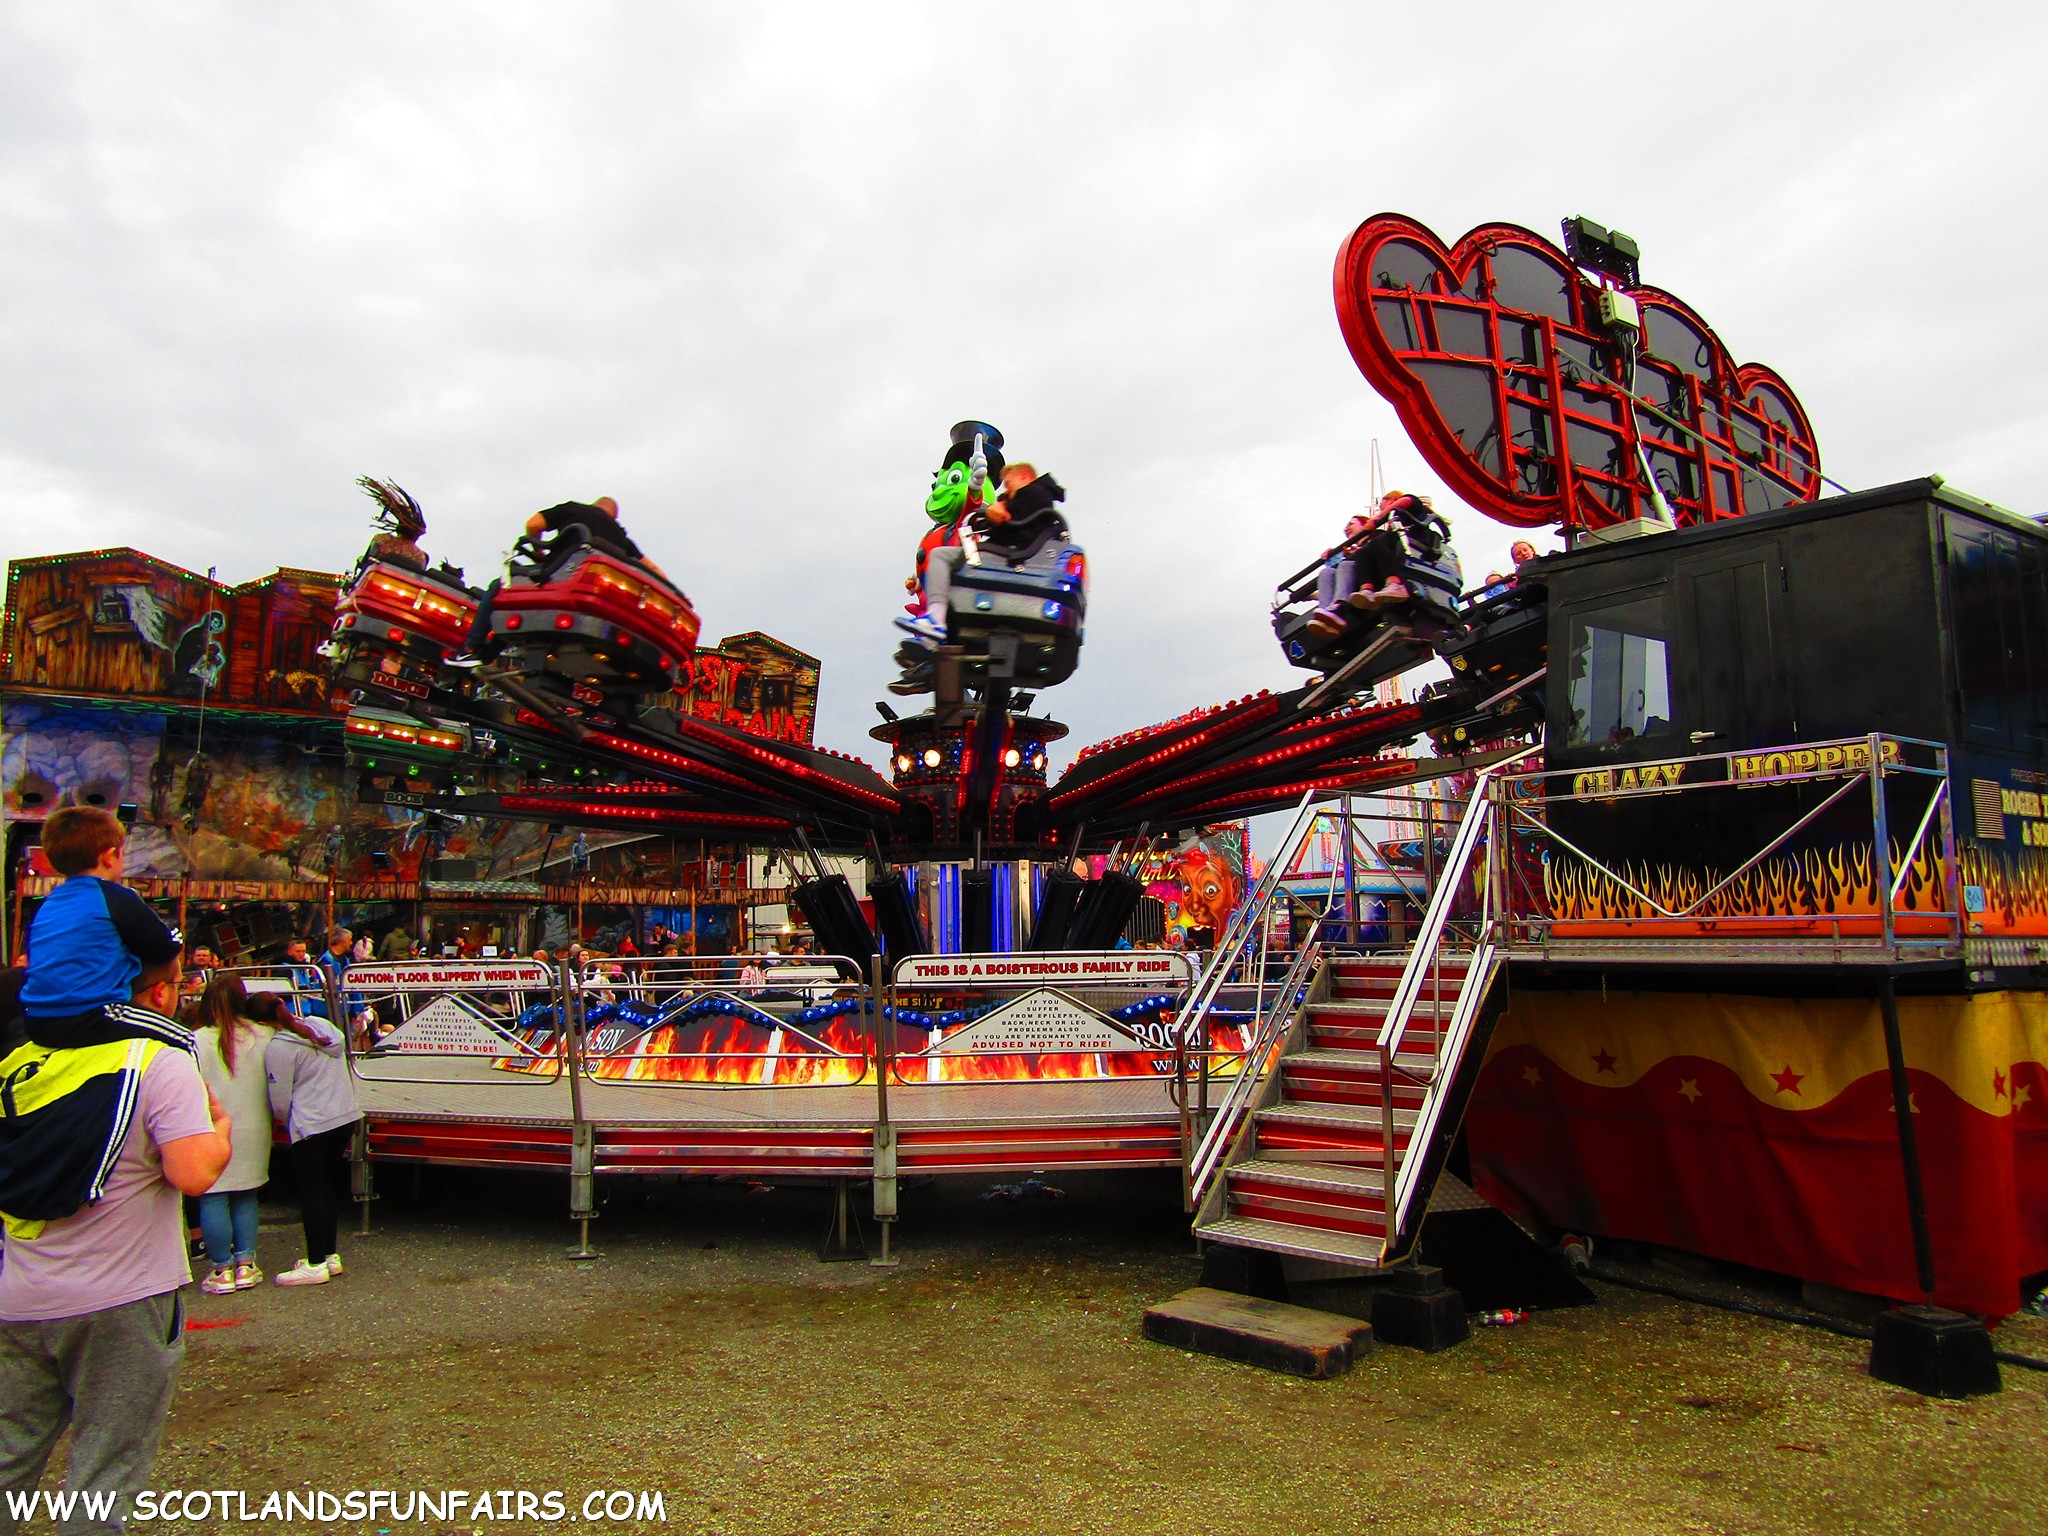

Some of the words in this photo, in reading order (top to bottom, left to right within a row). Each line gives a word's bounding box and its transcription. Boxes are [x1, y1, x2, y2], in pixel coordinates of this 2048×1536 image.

[914, 965, 950, 976] THIS
[953, 965, 968, 976] IS
[971, 964, 983, 975] A
[986, 963, 1078, 974] BOISTEROUS
[1082, 961, 1134, 973] FAMILY
[1137, 961, 1170, 972] RIDE
[347, 973, 394, 984] CAUTION:
[396, 972, 430, 982] FLOOR
[432, 971, 482, 982] SLIPPERY
[484, 970, 517, 981] WHEN
[518, 969, 542, 980] WET
[591, 1028, 625, 1050] SON
